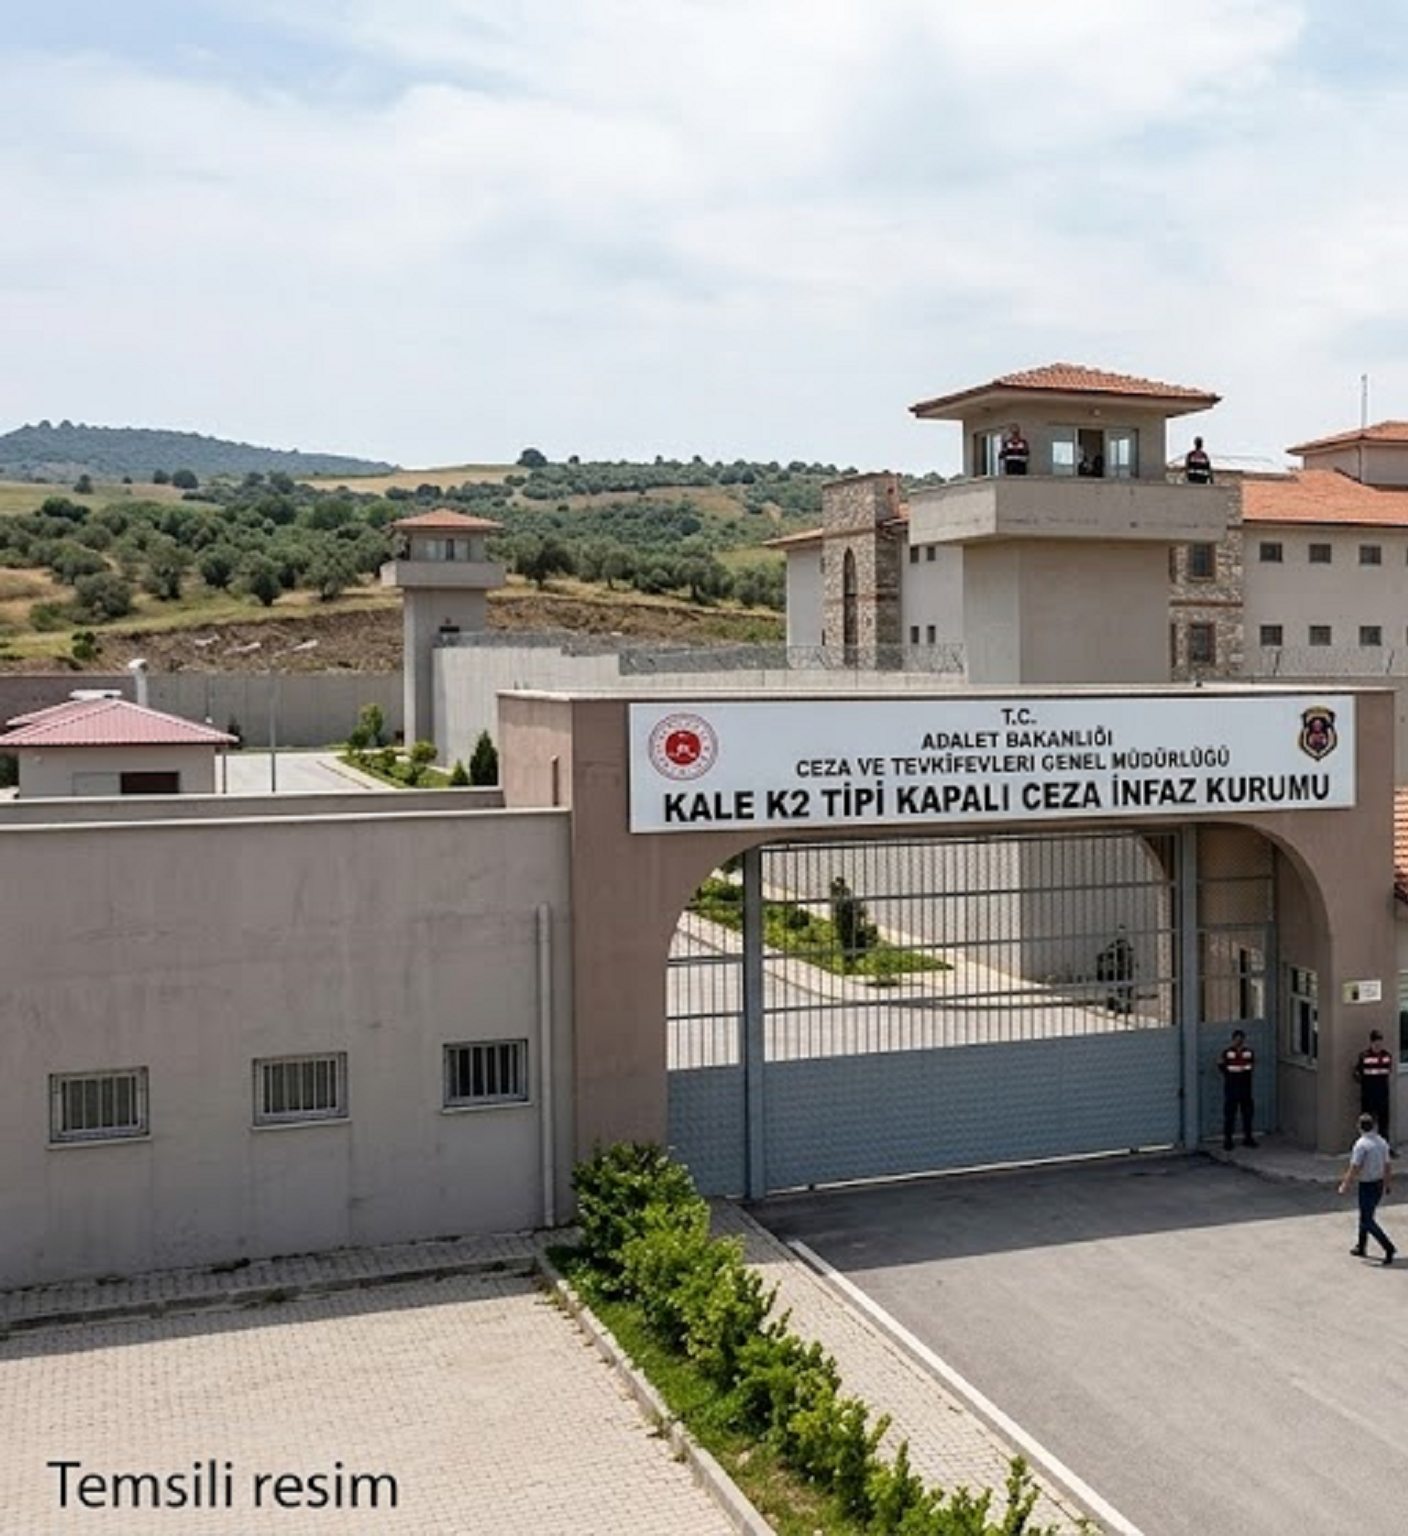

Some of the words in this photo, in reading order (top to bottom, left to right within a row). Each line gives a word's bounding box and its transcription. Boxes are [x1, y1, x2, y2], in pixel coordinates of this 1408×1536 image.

[1001, 708, 1037, 725] T.C.
[922, 732, 999, 749] ADALET
[1006, 723, 1112, 747] BAKANLIĞI
[796, 759, 852, 777] CEZA
[858, 758, 885, 776] VE
[1042, 753, 1106, 771] GENEL
[1112, 744, 1229, 769] MÜDÜRLÜĞÜ
[665, 791, 754, 822] KALE
[767, 790, 809, 819] K2
[821, 780, 884, 817] TİPİ
[897, 784, 1009, 814] KAPALI
[1022, 781, 1101, 810] CEZA
[1113, 774, 1196, 806] İNFAZ
[1207, 774, 1329, 803] KURUMU
